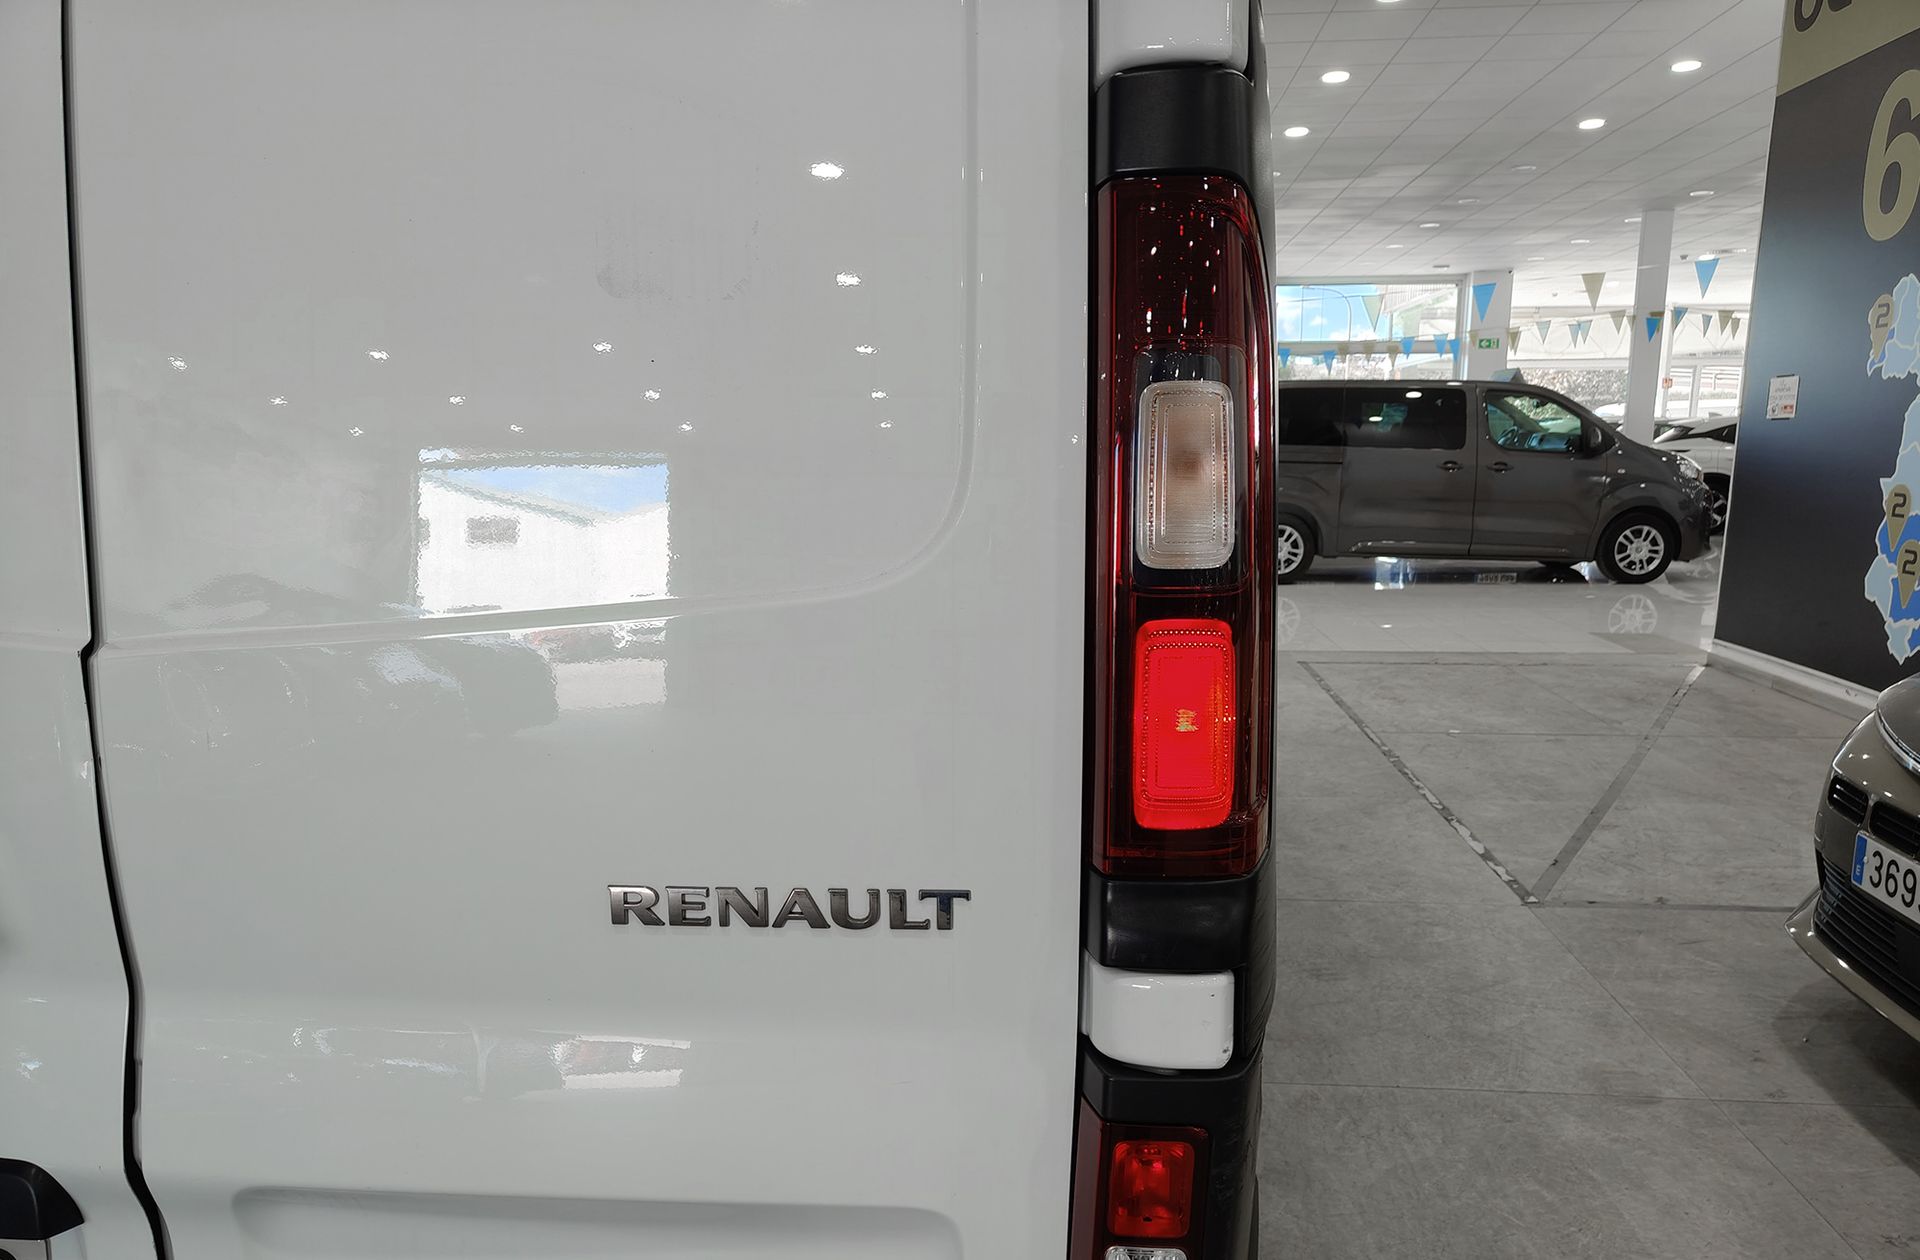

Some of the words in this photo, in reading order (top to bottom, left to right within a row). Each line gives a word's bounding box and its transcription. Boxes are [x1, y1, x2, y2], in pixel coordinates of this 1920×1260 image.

[1862, 69, 1920, 241] 6
[1875, 303, 1890, 329] 2
[1891, 492, 1908, 518] 2
[1902, 548, 1918, 576] 2
[1869, 850, 1920, 912] 369
[607, 883, 972, 931] RENAULT
